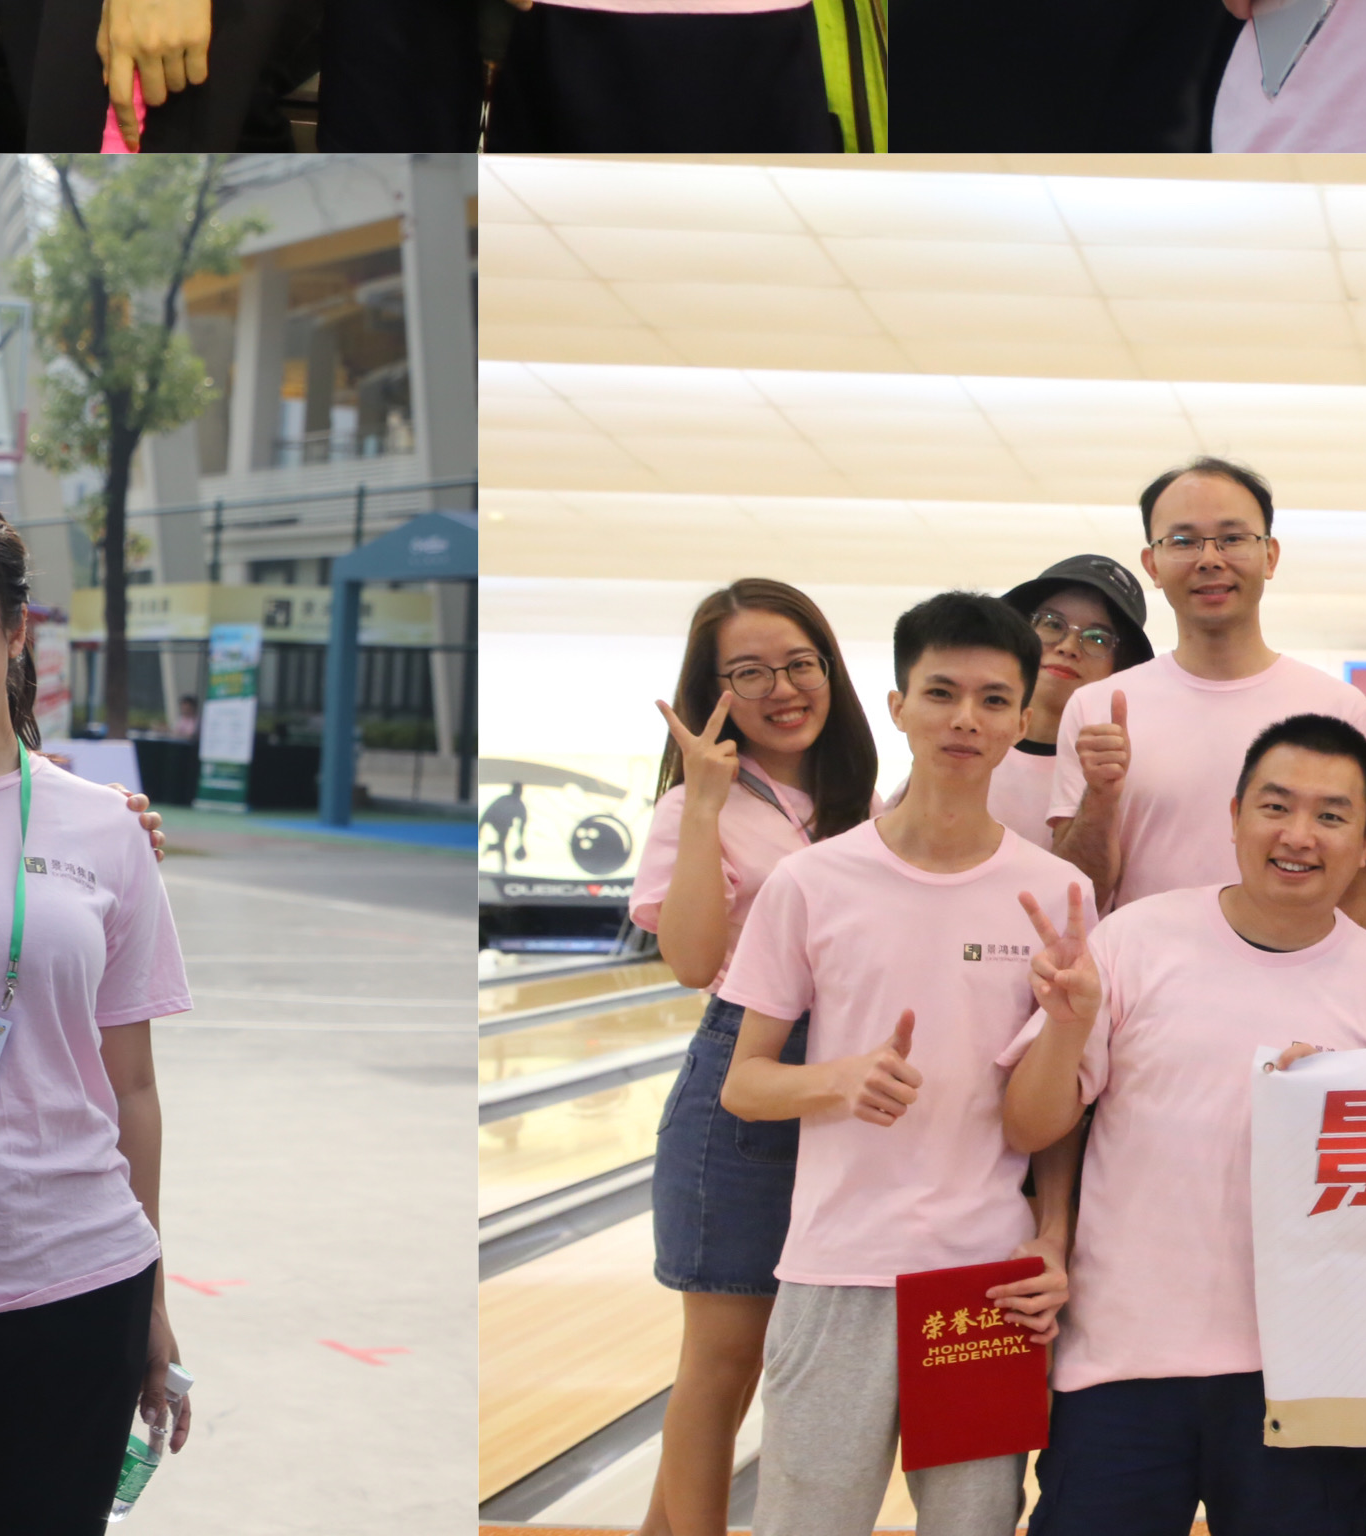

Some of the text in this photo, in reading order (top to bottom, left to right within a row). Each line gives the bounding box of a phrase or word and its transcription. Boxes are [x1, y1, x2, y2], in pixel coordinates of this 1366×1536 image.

[922, 1307, 1020, 1340] 荣誉证
[922, 1345, 1031, 1367] CREDENTIAL
[928, 1335, 1024, 1357] HONORARY
